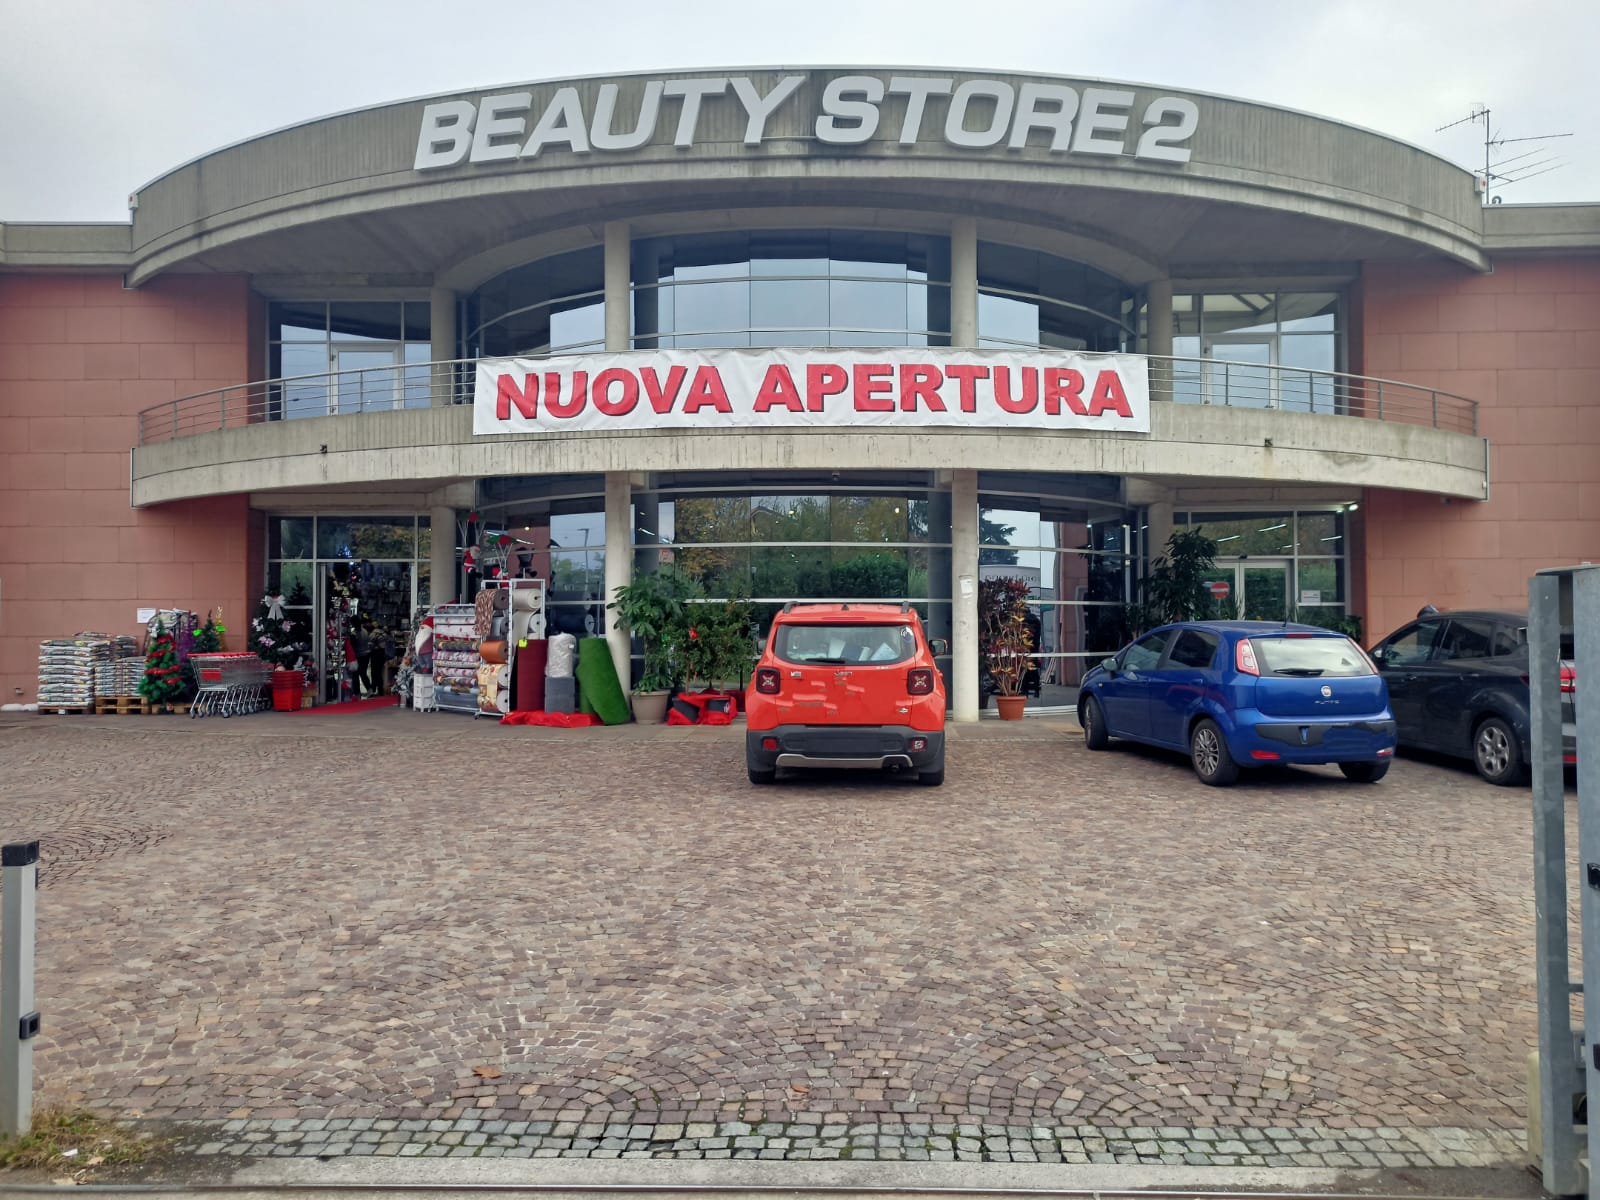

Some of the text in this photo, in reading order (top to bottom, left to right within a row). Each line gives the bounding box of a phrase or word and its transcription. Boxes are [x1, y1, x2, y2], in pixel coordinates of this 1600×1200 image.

[414, 76, 1199, 171] BEAUTY STORE 2
[496, 363, 1133, 420] NUOVA APERTURA
